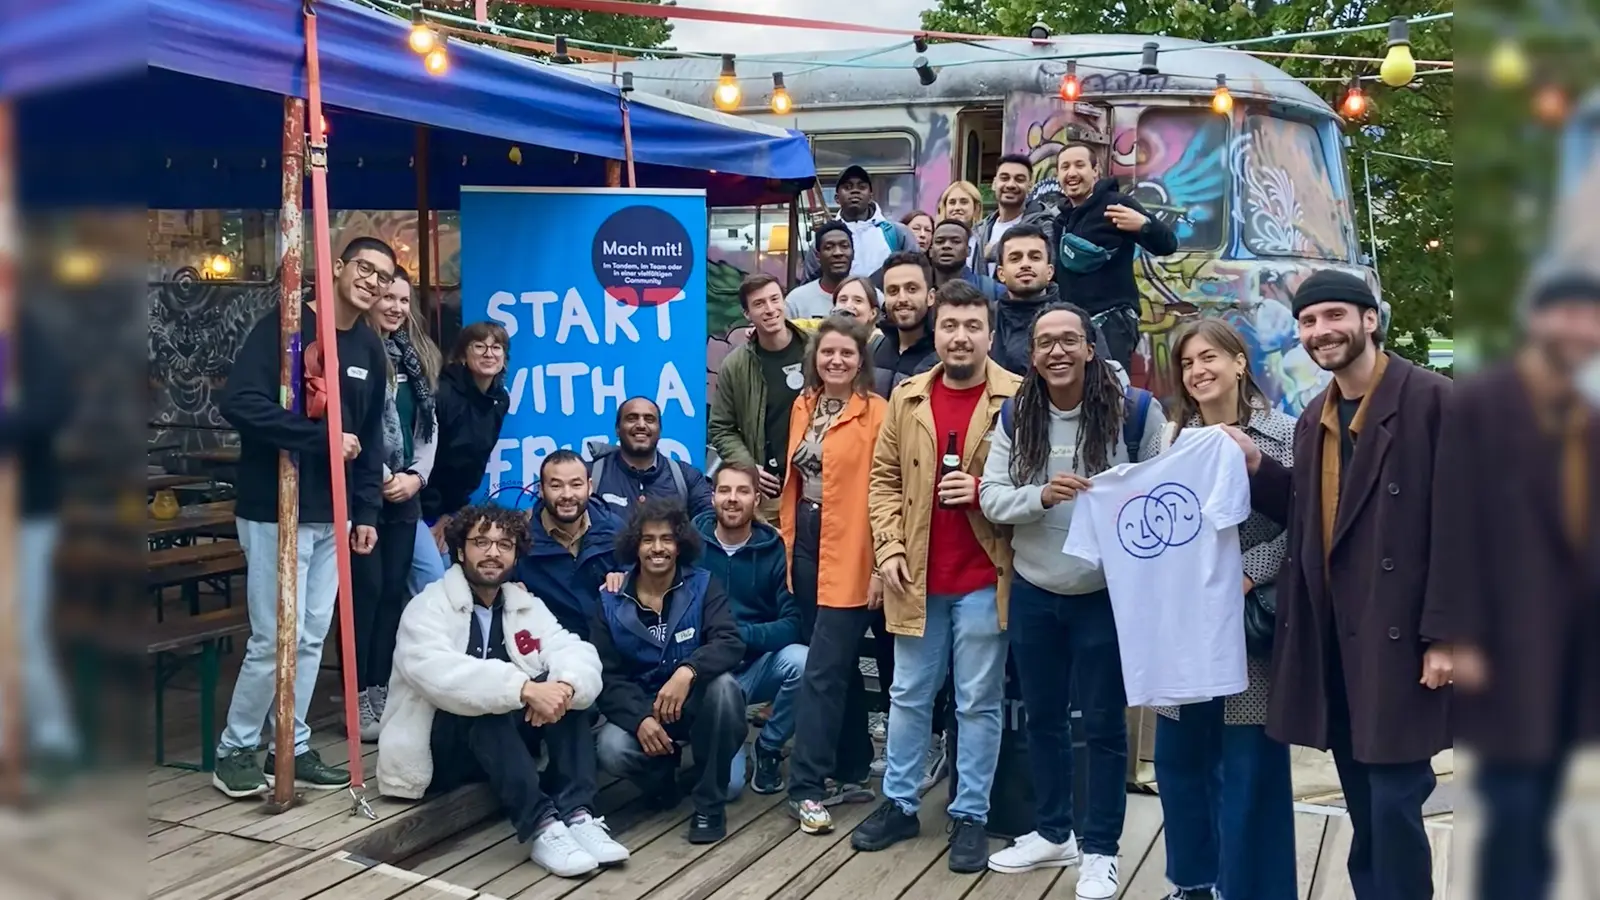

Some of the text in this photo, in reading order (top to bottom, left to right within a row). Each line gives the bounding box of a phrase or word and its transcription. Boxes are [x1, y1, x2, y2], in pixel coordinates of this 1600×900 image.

[603, 241, 682, 256] Mach mit!
[612, 262, 639, 270] Tandem,
[624, 277, 662, 285] Community
[486, 287, 686, 345] START
[655, 361, 695, 417] A
